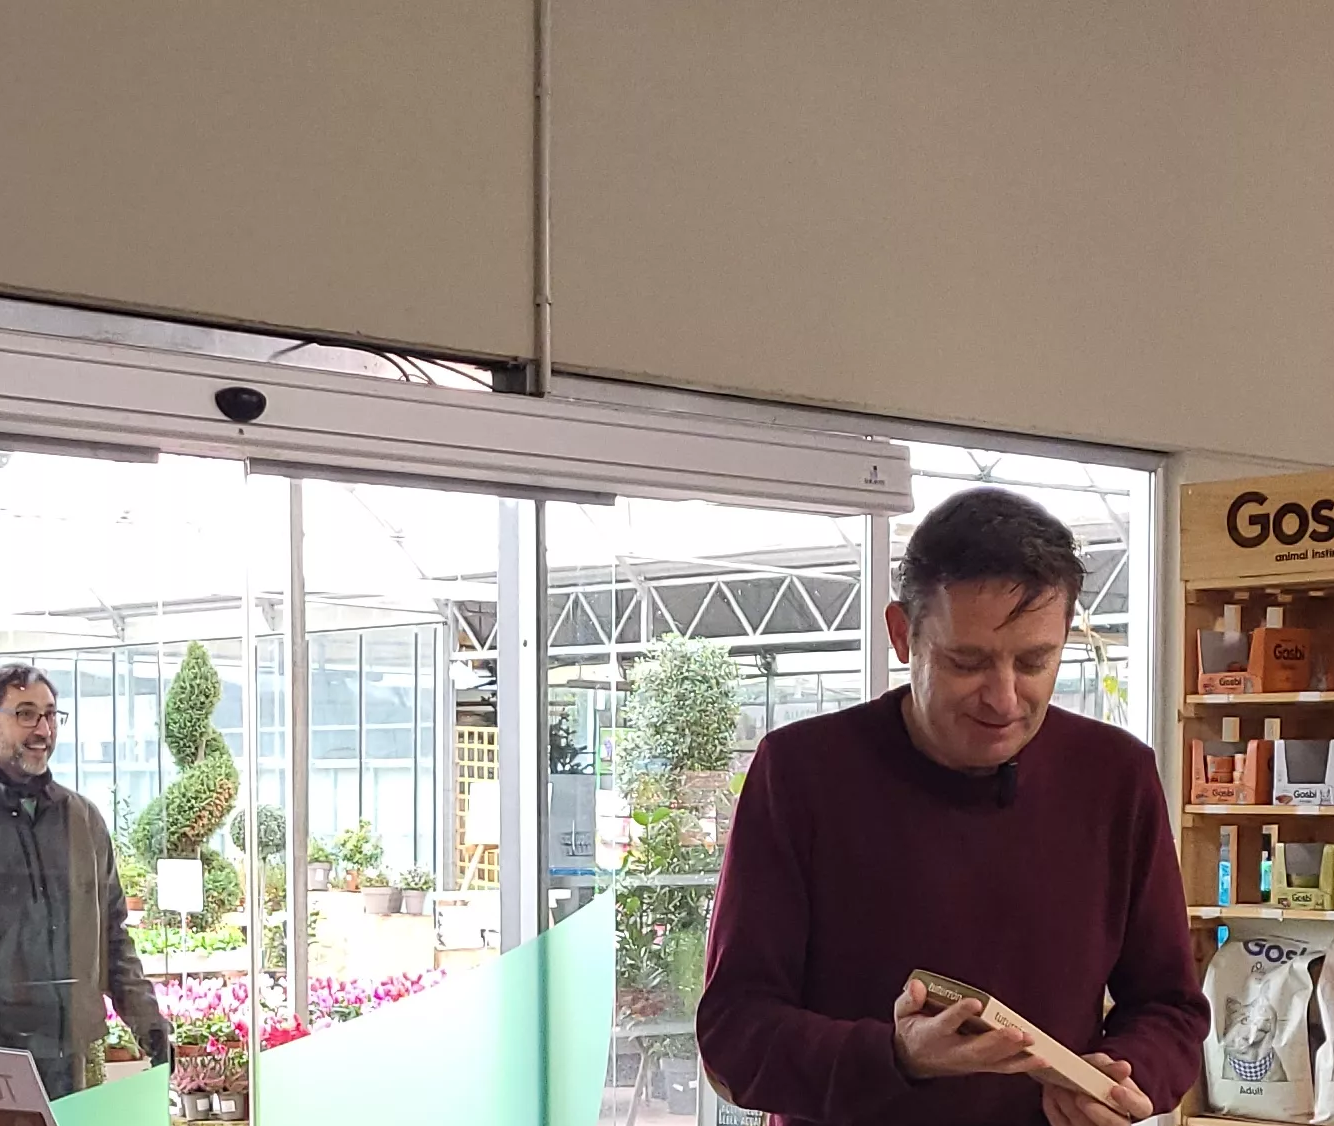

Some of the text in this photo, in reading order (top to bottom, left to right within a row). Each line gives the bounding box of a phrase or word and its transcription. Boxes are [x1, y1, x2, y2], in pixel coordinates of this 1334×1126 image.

[1275, 549, 1308, 562] animal
[1273, 644, 1305, 660] Gosbi
[1219, 677, 1242, 687] Gosbi
[1293, 789, 1317, 799] Gosbi
[1240, 1085, 1264, 1096] Adult
